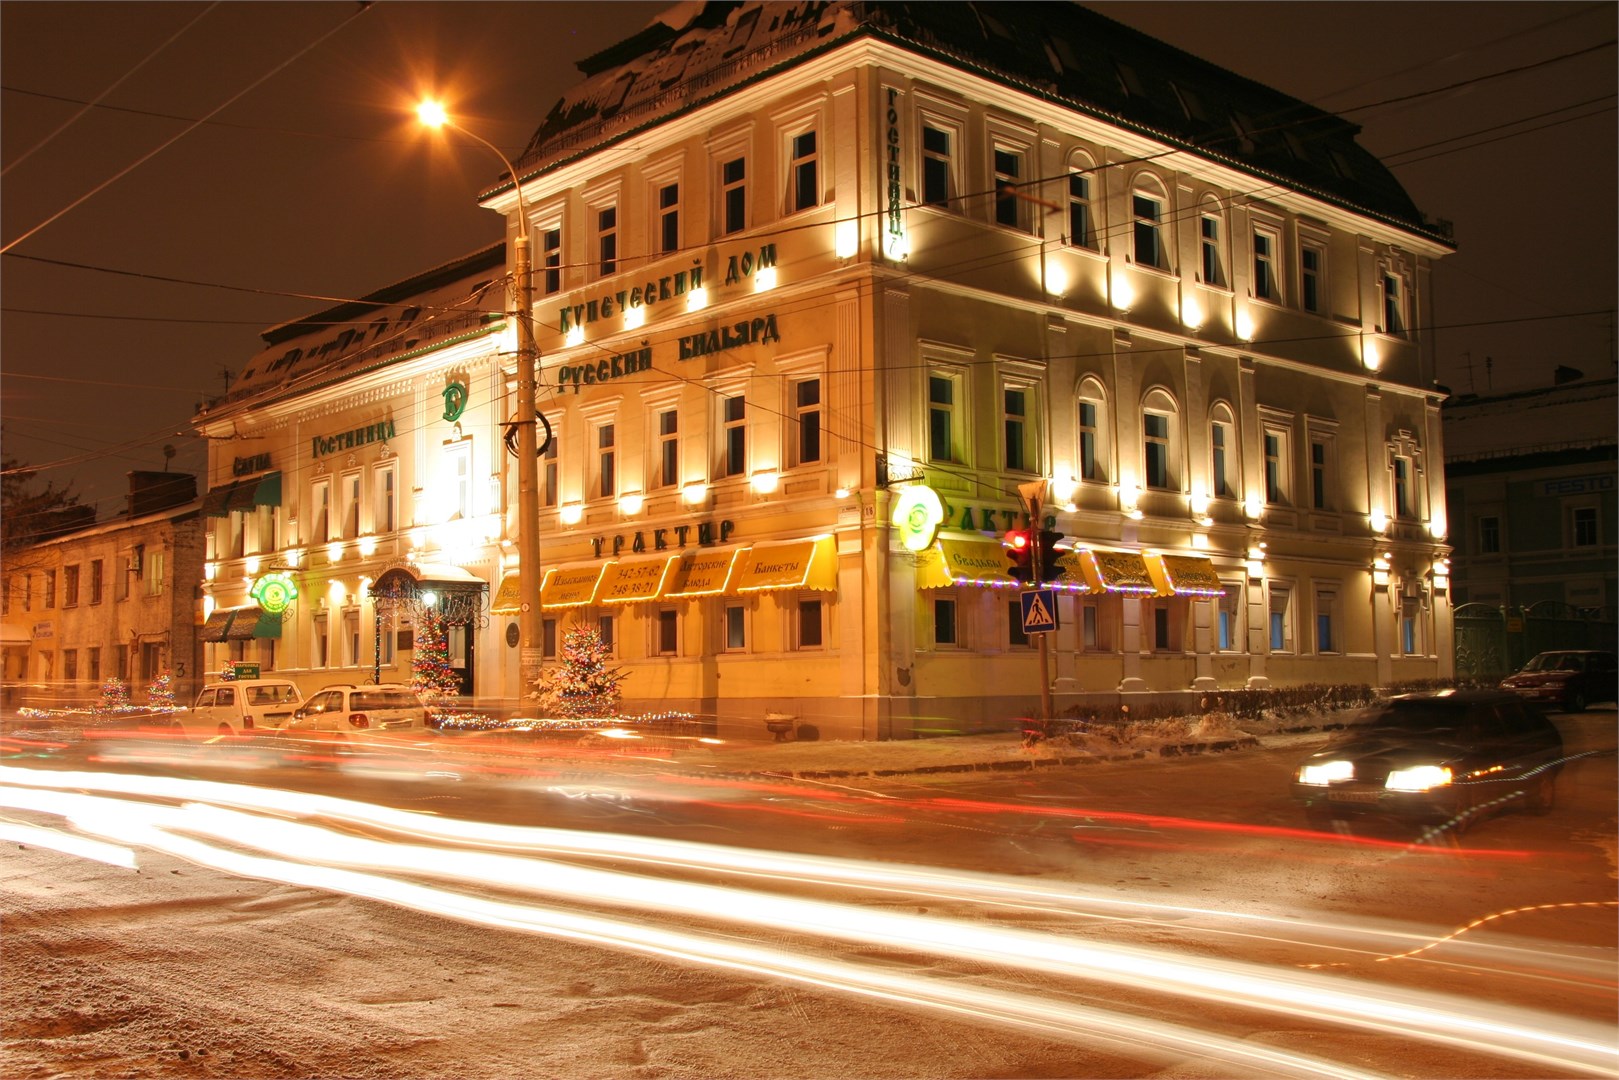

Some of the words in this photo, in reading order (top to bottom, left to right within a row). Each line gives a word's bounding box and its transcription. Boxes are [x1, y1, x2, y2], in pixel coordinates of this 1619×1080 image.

[1544, 476, 1614, 495] FESTO
[590, 520, 735, 557] ТРАКТИР
[753, 561, 799, 575] Банкеты
